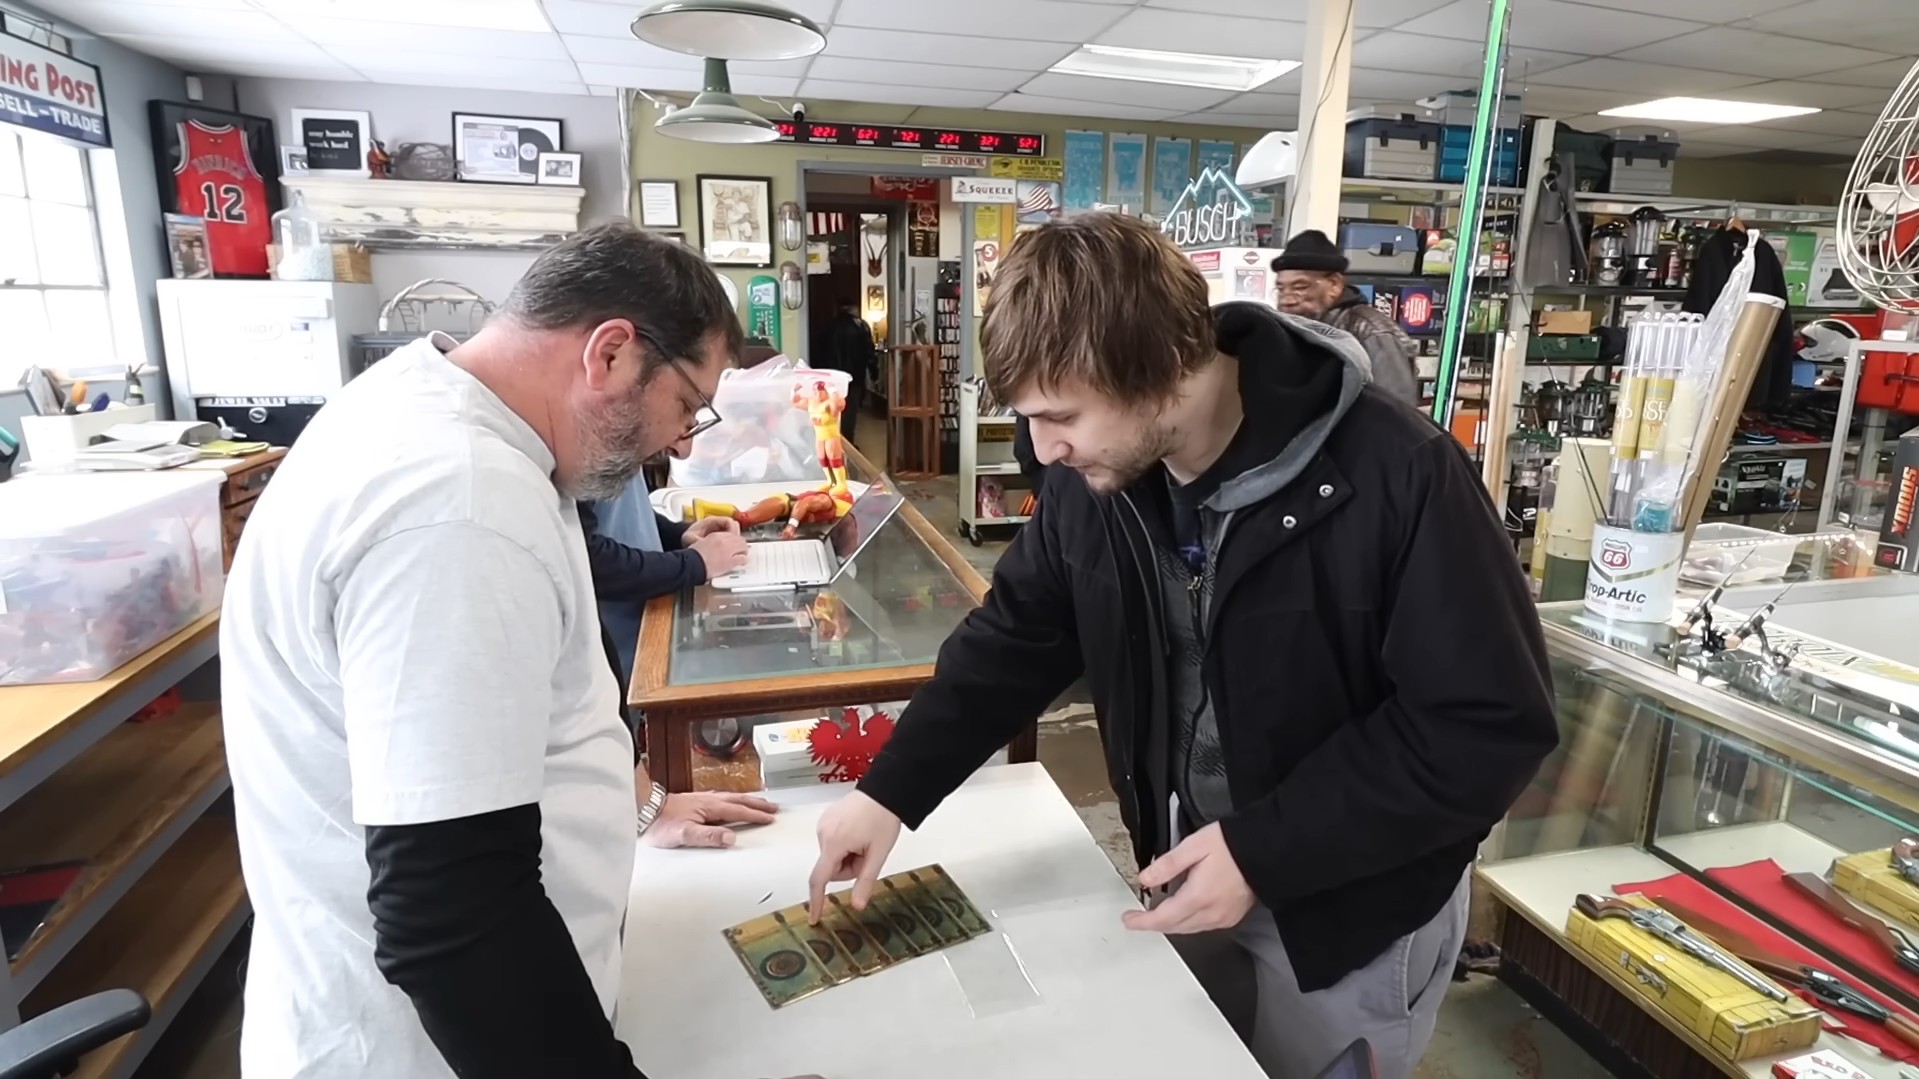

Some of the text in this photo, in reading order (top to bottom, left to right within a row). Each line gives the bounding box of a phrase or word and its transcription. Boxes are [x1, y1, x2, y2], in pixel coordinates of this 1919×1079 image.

[45, 62, 95, 108] POST
[858, 128, 879, 140] 621
[900, 130, 919, 142] 721
[940, 133, 960, 144] 221
[980, 135, 999, 146] 321
[1019, 137, 1038, 149] 521
[201, 181, 248, 224] 12
[969, 184, 1013, 195] SQUEEZE
[1174, 201, 1237, 245] BUSCH
[1603, 550, 1626, 566] 66
